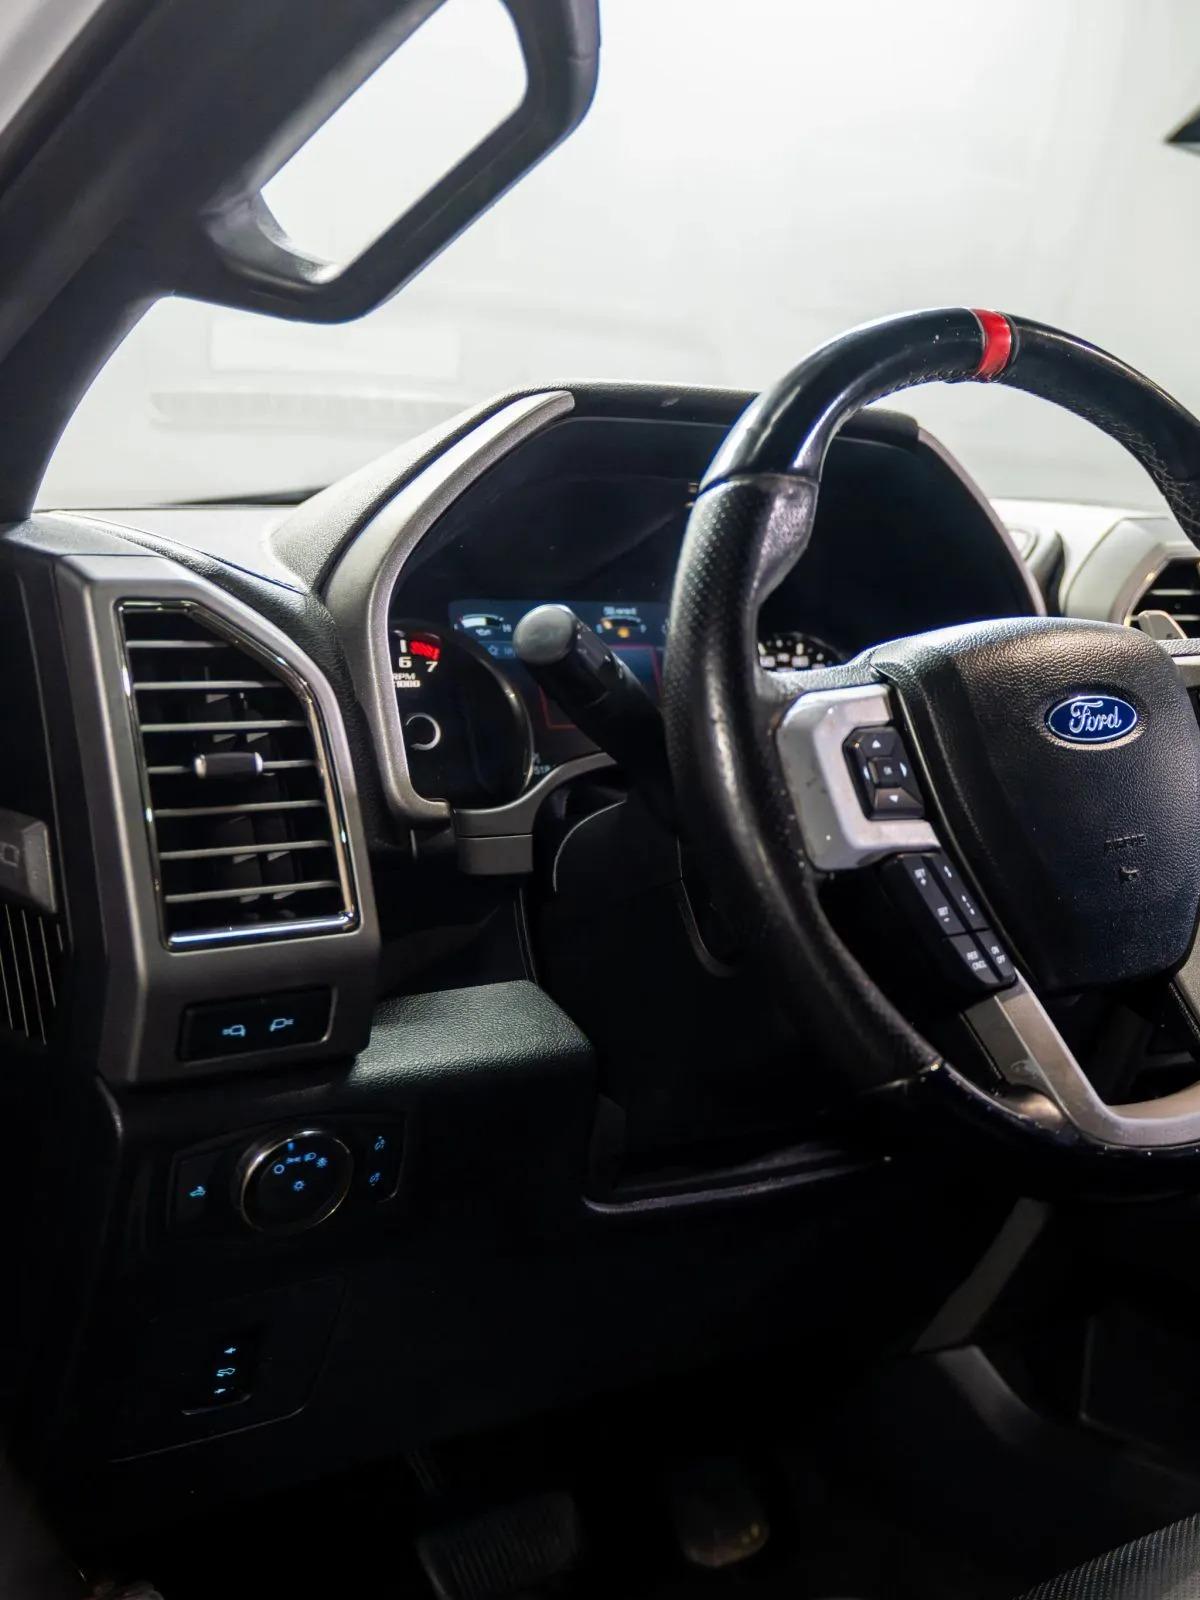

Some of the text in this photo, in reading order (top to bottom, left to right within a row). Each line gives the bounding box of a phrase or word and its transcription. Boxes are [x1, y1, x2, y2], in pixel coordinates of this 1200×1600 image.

[398, 656, 412, 668] 6
[426, 661, 438, 672] 7
[1069, 700, 1122, 733] Ford
